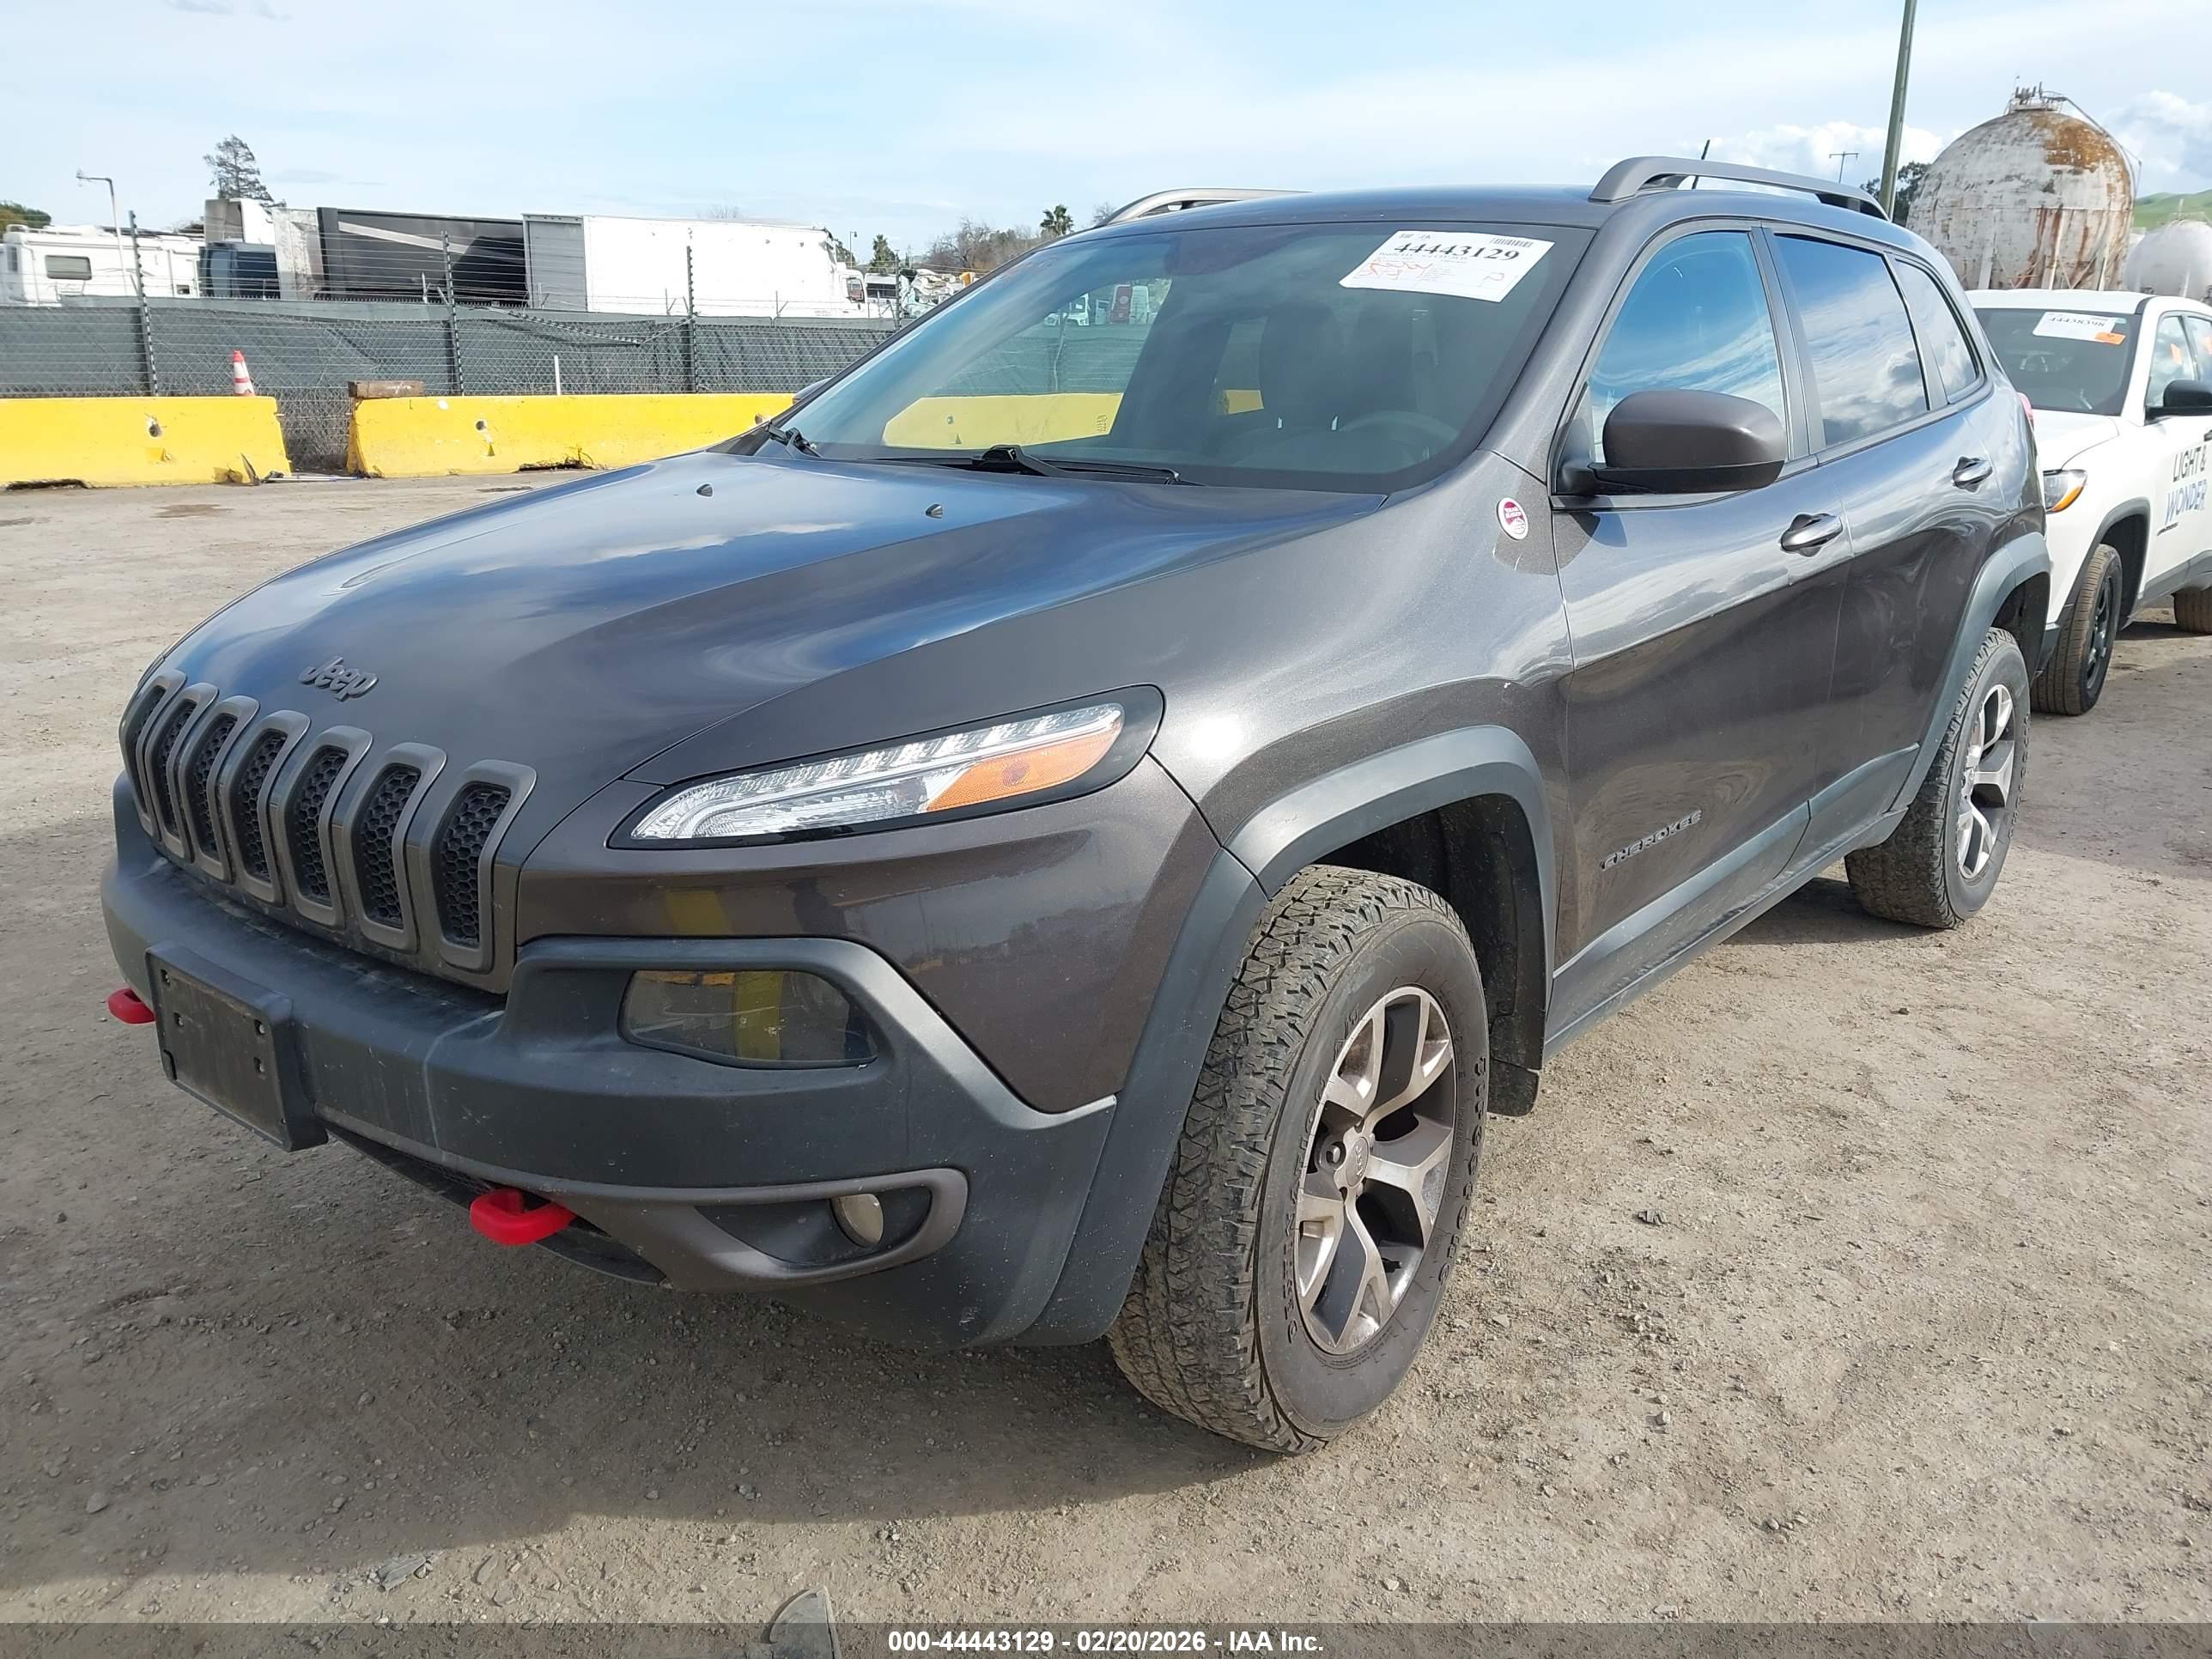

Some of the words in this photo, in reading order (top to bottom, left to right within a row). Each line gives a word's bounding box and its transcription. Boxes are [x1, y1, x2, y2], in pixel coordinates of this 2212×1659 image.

[1394, 242, 1520, 262] 44443129
[2172, 447, 2202, 483] LIGHT
[2165, 479, 2207, 526] WONDER
[298, 655, 380, 702] Jeep
[1600, 810, 1702, 872] CHEROKEE
